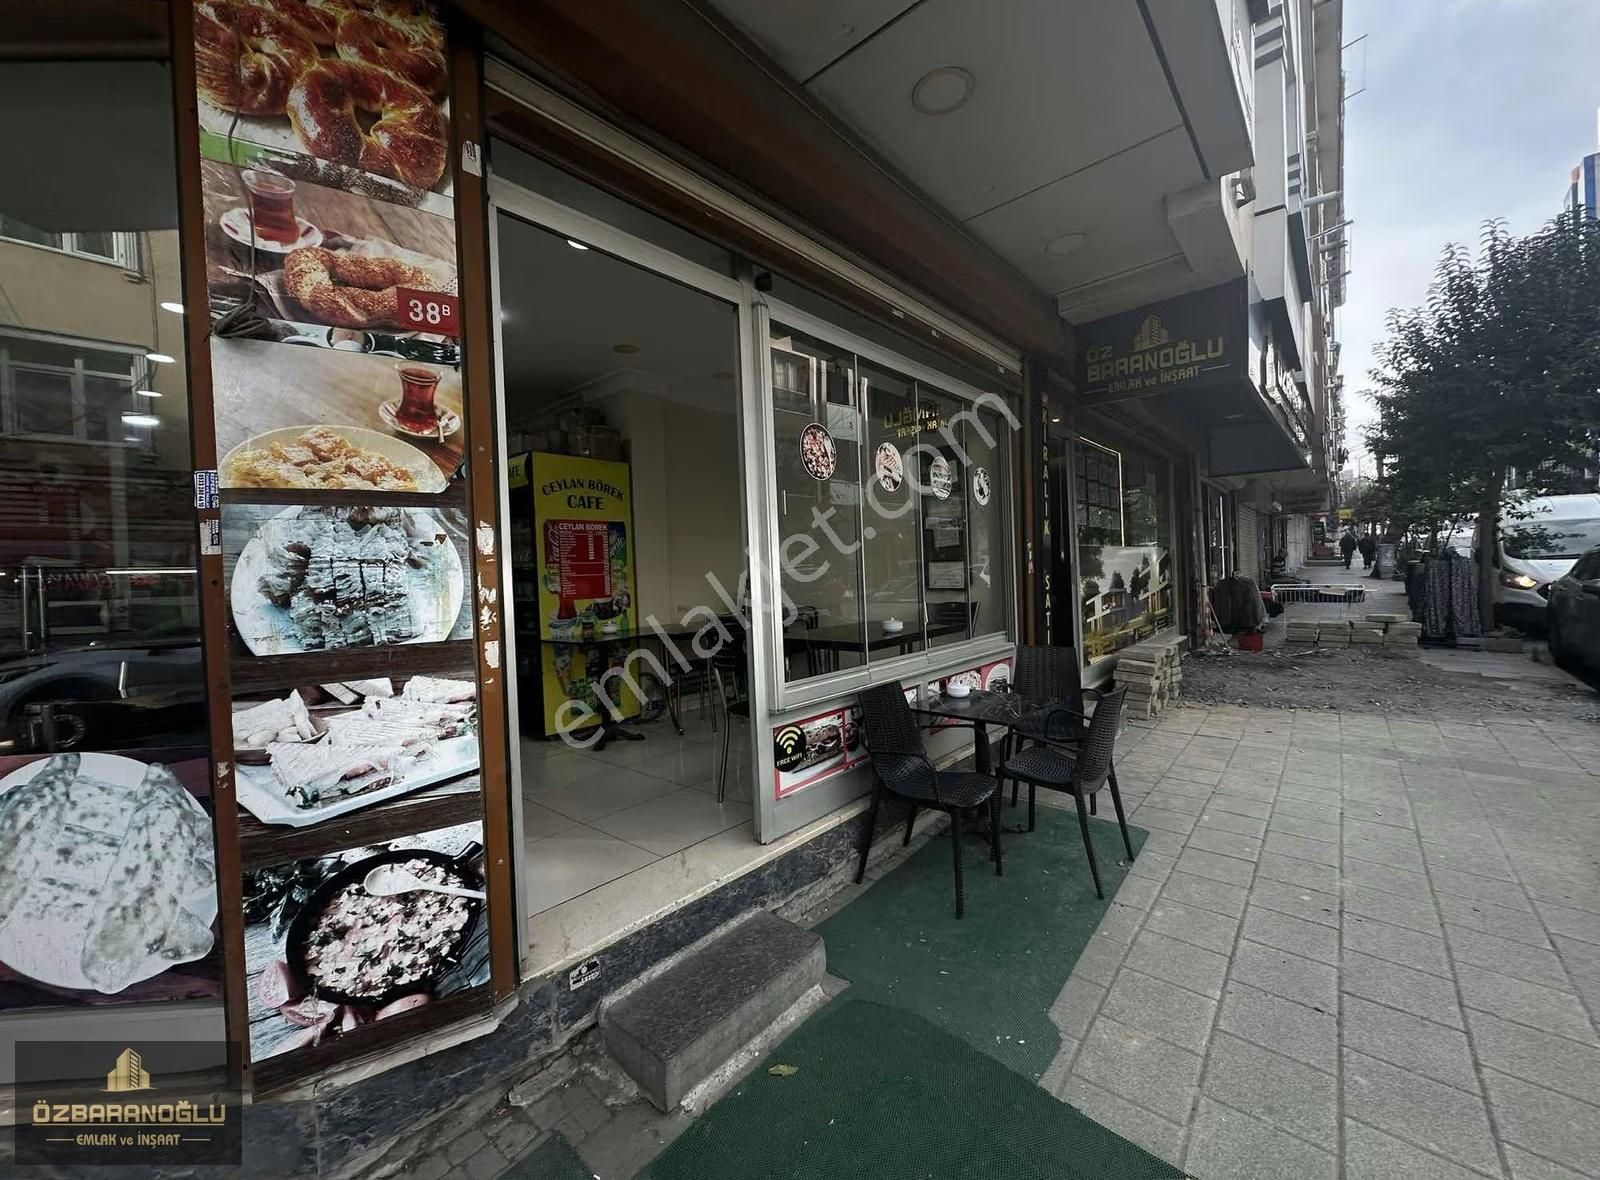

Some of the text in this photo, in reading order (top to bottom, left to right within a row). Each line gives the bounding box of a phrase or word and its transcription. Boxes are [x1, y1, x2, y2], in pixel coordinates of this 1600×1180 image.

[1087, 336, 1224, 383] BARANOĞLU
[1107, 366, 1200, 393] EMLAK ve İNŞAAT
[542, 479, 625, 501] CEYLAN BÖREK
[567, 495, 604, 510] CAFE
[559, 522, 585, 531] CEYLAN
[777, 757, 790, 767] FREE
